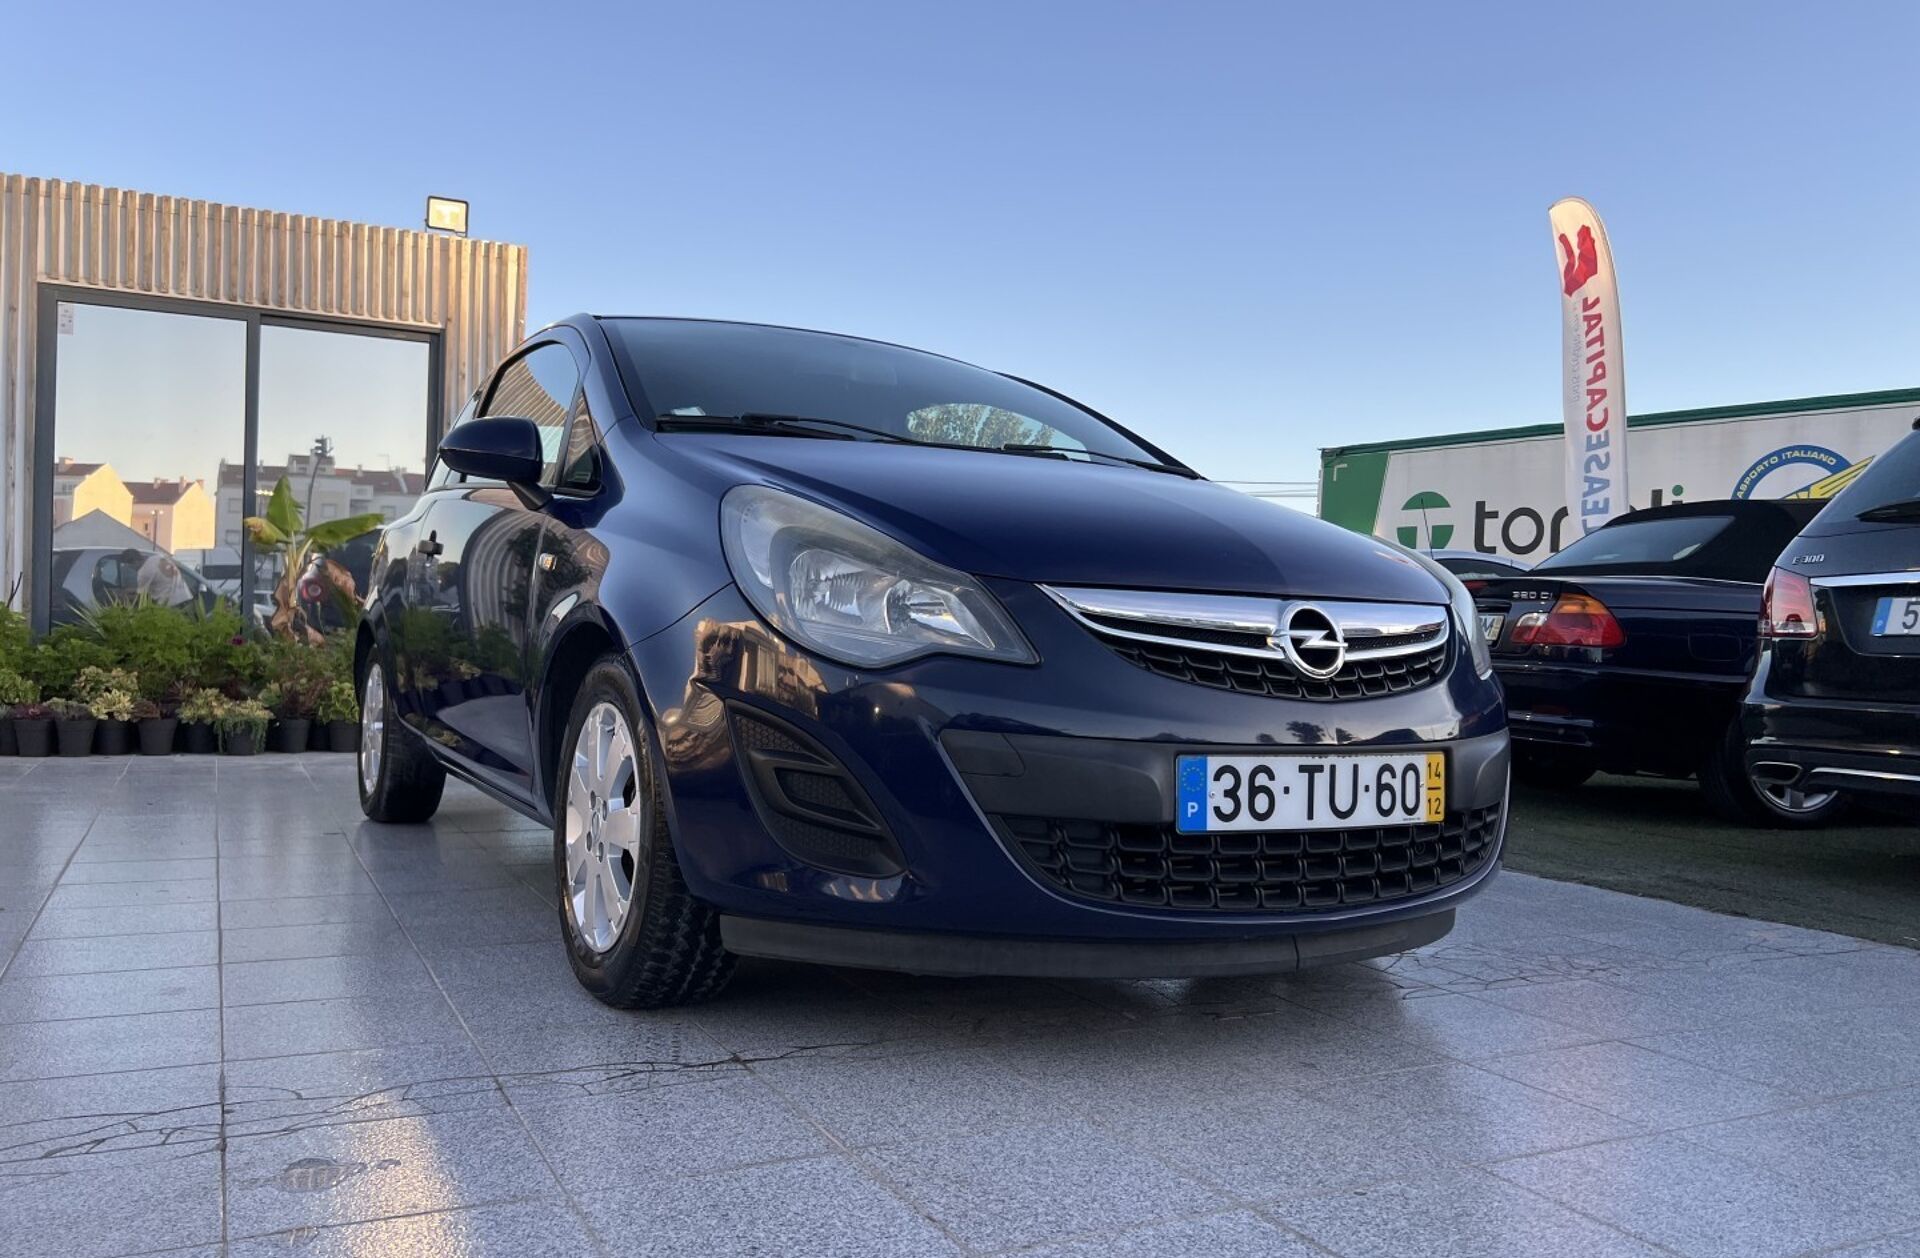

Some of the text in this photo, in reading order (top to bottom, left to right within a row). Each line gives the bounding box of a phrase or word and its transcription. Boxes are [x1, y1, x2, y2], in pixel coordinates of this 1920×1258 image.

[1782, 450, 1837, 466] ITALIANO
[1427, 760, 1441, 779] 14
[1187, 802, 1199, 818] P
[1427, 797, 1441, 815] 12
